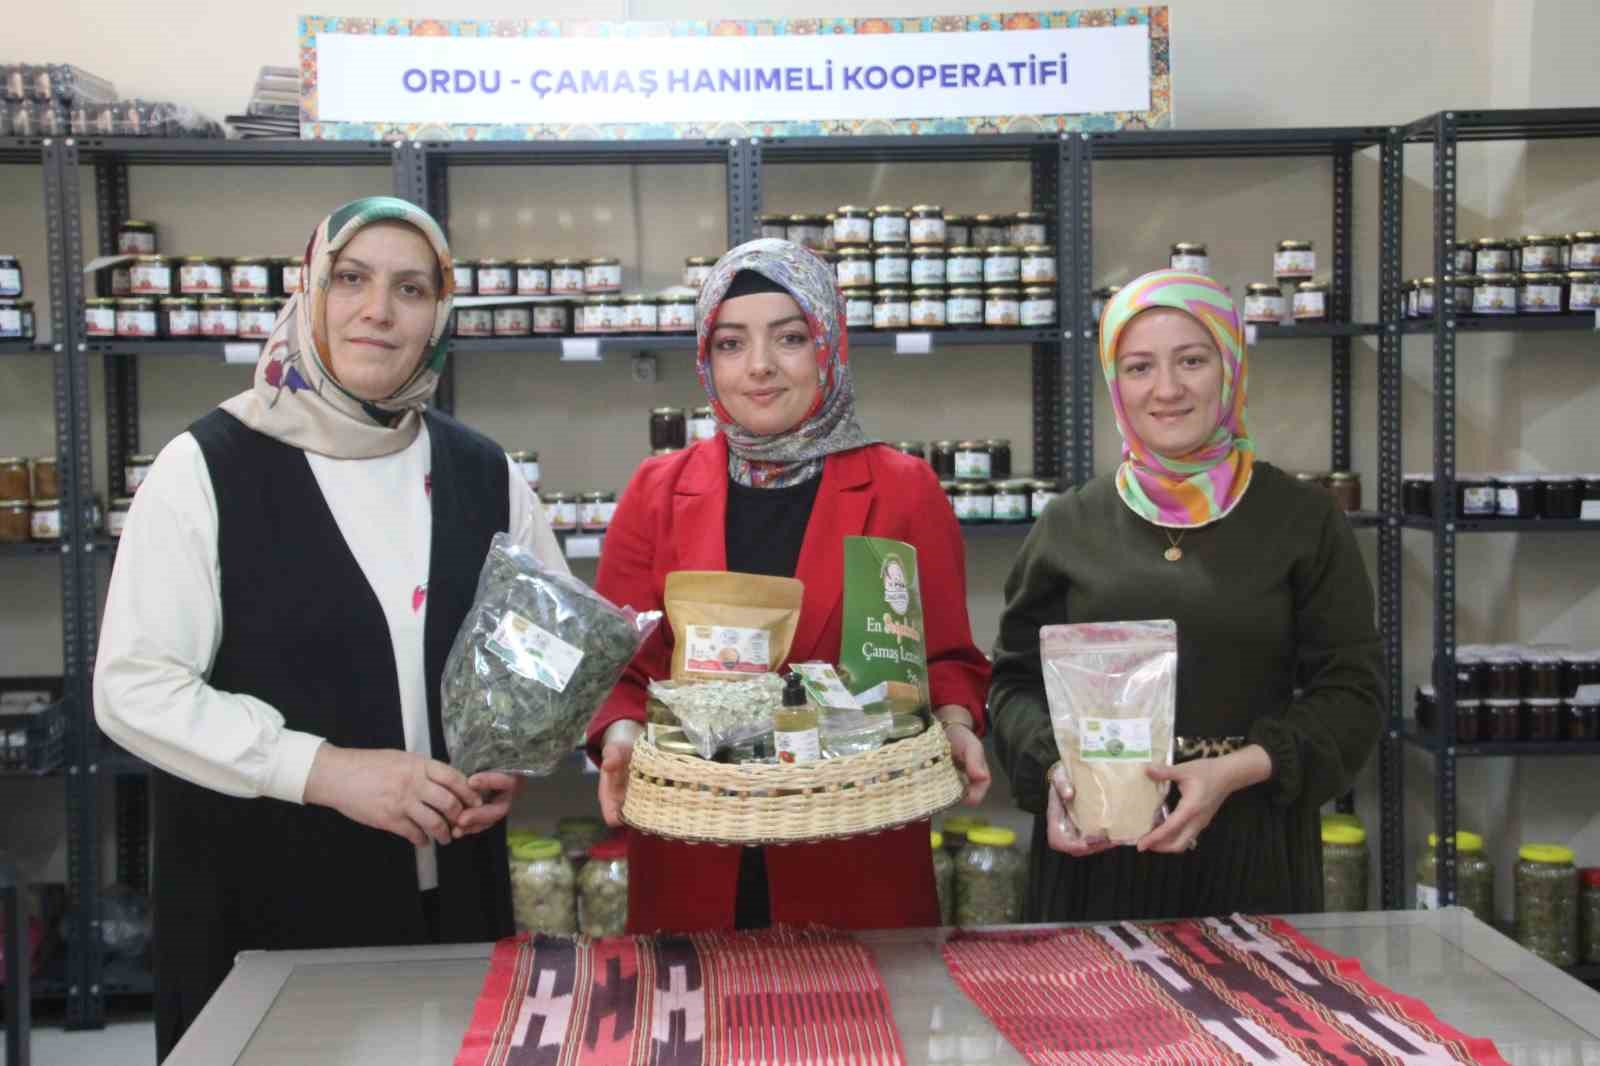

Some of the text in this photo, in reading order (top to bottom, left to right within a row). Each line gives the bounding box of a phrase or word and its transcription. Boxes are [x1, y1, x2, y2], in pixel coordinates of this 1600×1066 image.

[403, 69, 502, 95] ORDU
[530, 69, 658, 99] ÇAMAŞ
[667, 59, 834, 93] HANIMELİ
[843, 52, 1069, 91] KOOPERATİFİ
[866, 616, 881, 632] En
[862, 641, 900, 663] Çamaş
